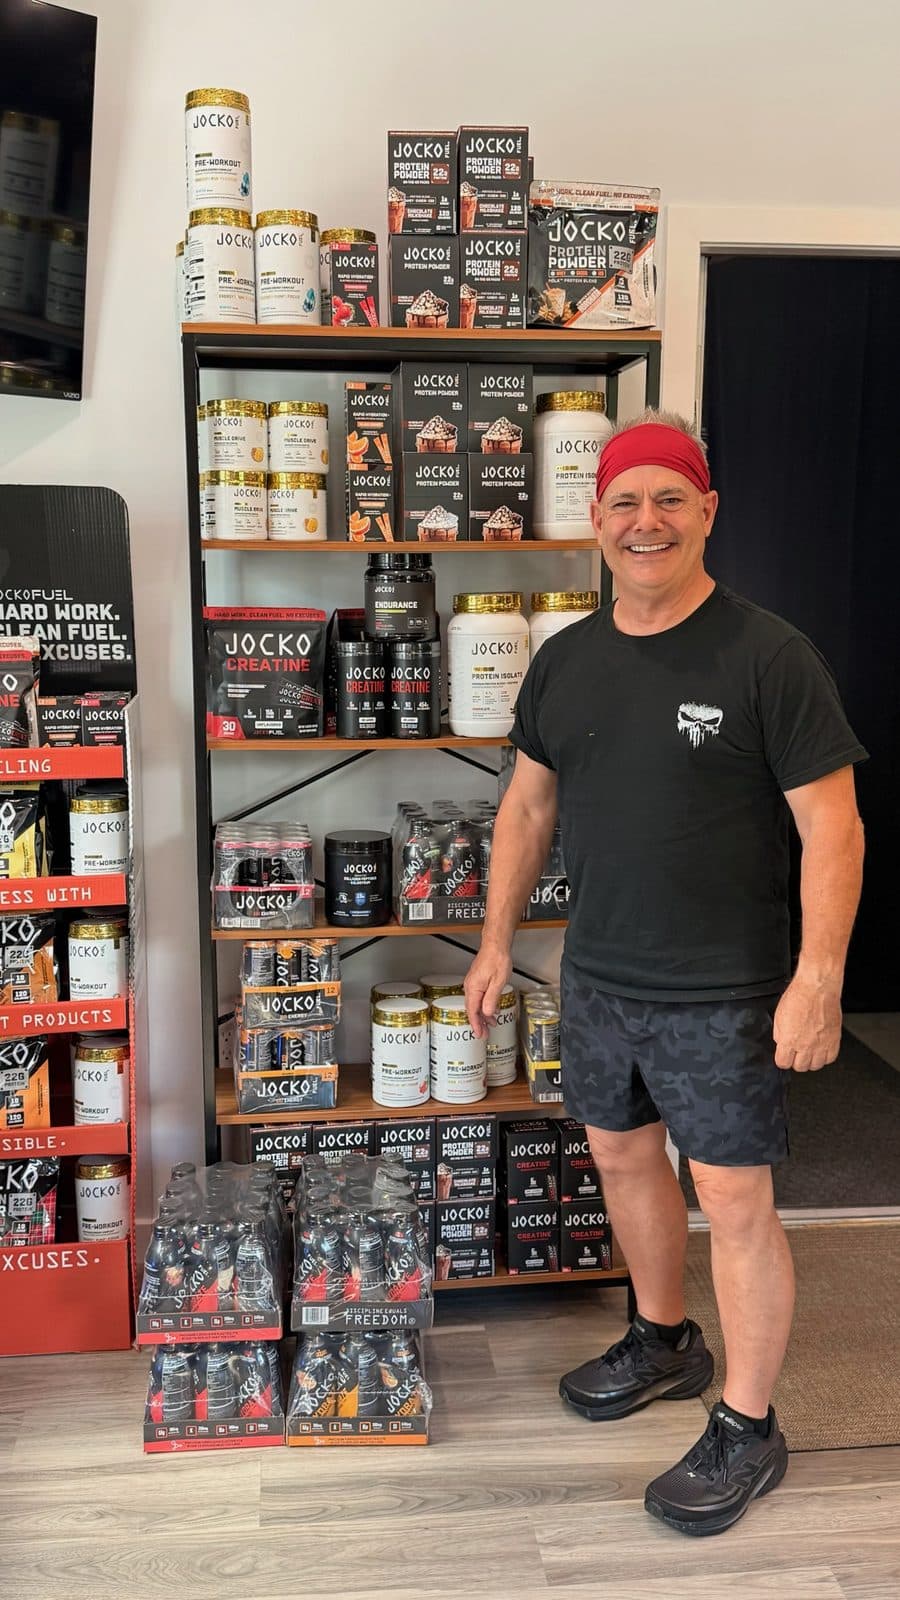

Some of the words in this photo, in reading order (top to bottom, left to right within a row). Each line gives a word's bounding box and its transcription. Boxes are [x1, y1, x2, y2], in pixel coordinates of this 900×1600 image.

[193, 113, 233, 129] JOCKO
[394, 142, 443, 158] JOCKO
[466, 138, 514, 153] JOCKO
[195, 159, 241, 168] PRE-WORKOUT
[394, 171, 429, 179] POWDER
[466, 166, 501, 174] POWDER
[548, 218, 625, 242] JOCKO
[260, 232, 296, 247] JOCKO
[404, 248, 445, 260] JOCKO
[466, 240, 513, 256] JOCKO
[549, 245, 606, 257] PROTEIN
[336, 256, 370, 268] JOCKO
[549, 256, 606, 269] POWDER
[614, 251, 631, 262] 22G
[414, 374, 453, 387] JOCKO
[481, 376, 519, 389] JOCKO
[351, 395, 384, 406] JOCKO
[214, 418, 238, 426] JOCKO
[284, 420, 310, 428] JOCKO
[556, 440, 598, 453] JOCKO
[416, 465, 454, 478] JOCKO
[482, 466, 520, 478] JOCKO
[353, 476, 385, 486] JOCKO
[234, 489, 258, 497] JOCKO
[270, 490, 291, 499] JOCKO
[0, 589, 73, 601] CKOFUEL
[0, 604, 48, 620] ARD
[55, 604, 120, 620] WORK.
[68, 624, 127, 640] FUEL.
[225, 633, 311, 656] JOCKO
[472, 642, 513, 655] JOCKO
[42, 644, 131, 660] XCUSES.
[226, 658, 310, 672] CREATINE
[346, 667, 385, 679] JOCKO
[391, 667, 430, 679] JOCKO
[346, 681, 384, 693] CREATINE
[391, 681, 430, 693] CREATINE
[42, 710, 75, 720] JOCKO
[85, 711, 119, 720] JOCKO
[222, 721, 235, 731] 30
[83, 822, 121, 833] JOCKO
[84, 858, 127, 866] PRE-WORKOUT
[344, 864, 373, 873] JOCKO
[445, 859, 473, 895] JOCKO
[48, 887, 92, 902] WITH
[236, 895, 285, 909] JOCKO
[448, 908, 485, 919] FREED
[261, 996, 314, 1012] JOCKO
[23, 1010, 112, 1027] PRODUCTS
[381, 1033, 417, 1044] JOCKO
[446, 1030, 475, 1041] JOCK
[5, 1073, 24, 1081] 22G
[382, 1067, 422, 1075] PRE-WORKOUT
[257, 1080, 310, 1098] JOCKO
[381, 1128, 424, 1143] JOCKO
[442, 1125, 485, 1140] JOCKO
[256, 1136, 300, 1151] JOCKO
[319, 1133, 362, 1148] JOCKO
[511, 1143, 551, 1157] JOCKO
[565, 1142, 591, 1154] JOC
[256, 1153, 288, 1161] PROTEIN
[516, 1160, 551, 1169] CREATINE
[80, 1186, 115, 1198] JOCKO
[441, 1207, 484, 1222] JOCKO
[565, 1213, 604, 1226] JOCKO
[512, 1214, 551, 1228] JOCKO
[570, 1230, 604, 1238] CREATINE
[3, 1250, 100, 1270] XCUSES.
[386, 1374, 418, 1413] JOCKO
